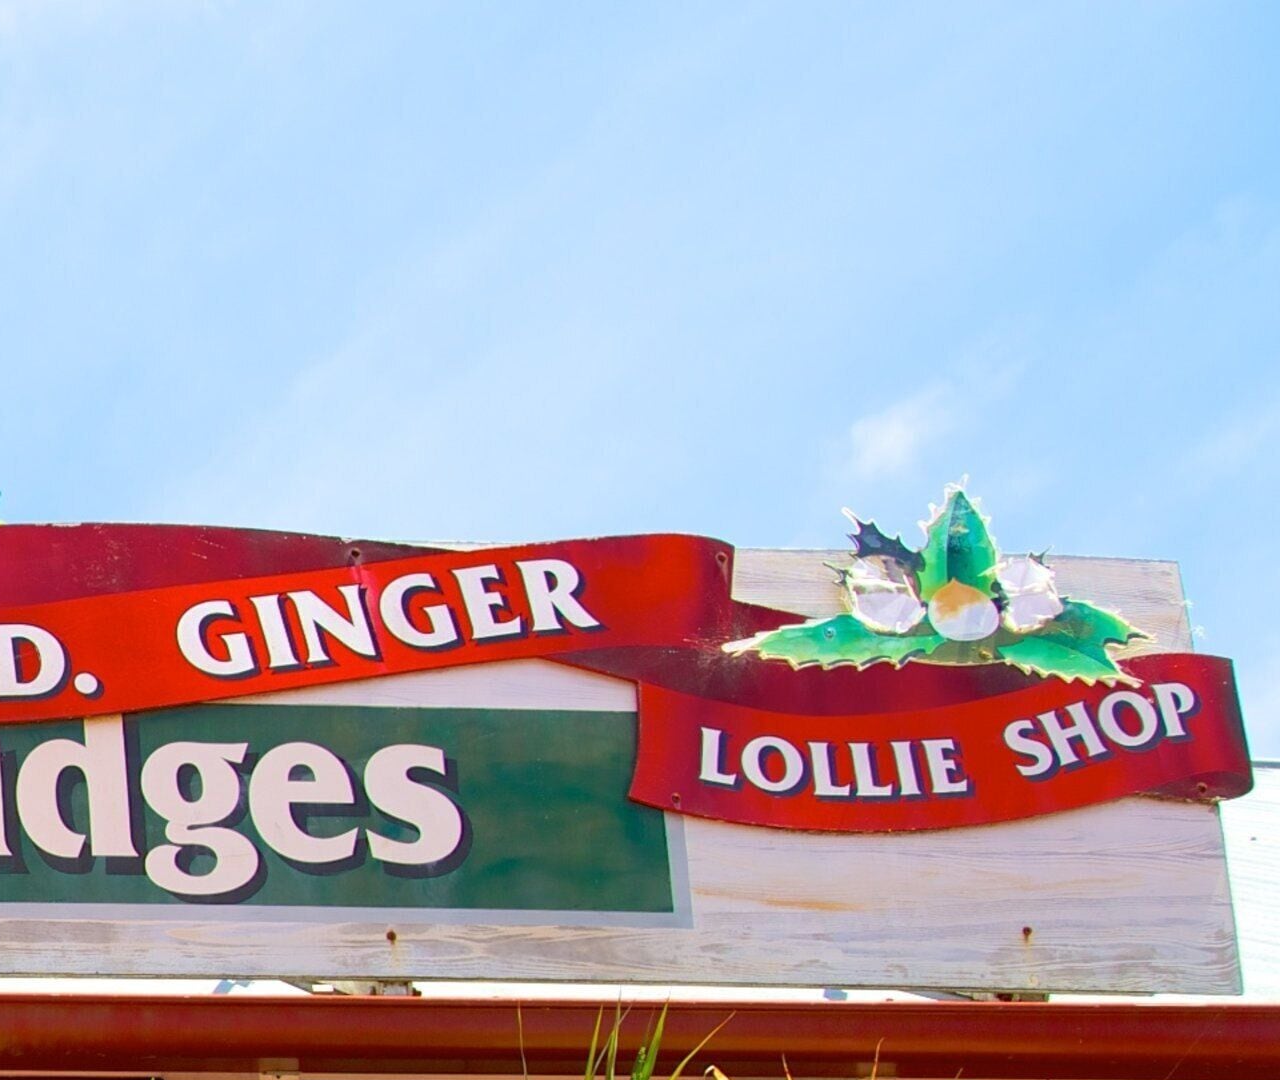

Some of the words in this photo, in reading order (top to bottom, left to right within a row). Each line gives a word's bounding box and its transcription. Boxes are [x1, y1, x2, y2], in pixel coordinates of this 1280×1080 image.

[177, 559, 601, 678] GINGER
[699, 727, 968, 797] LOLLIE
[1004, 683, 1196, 779] SHOP
